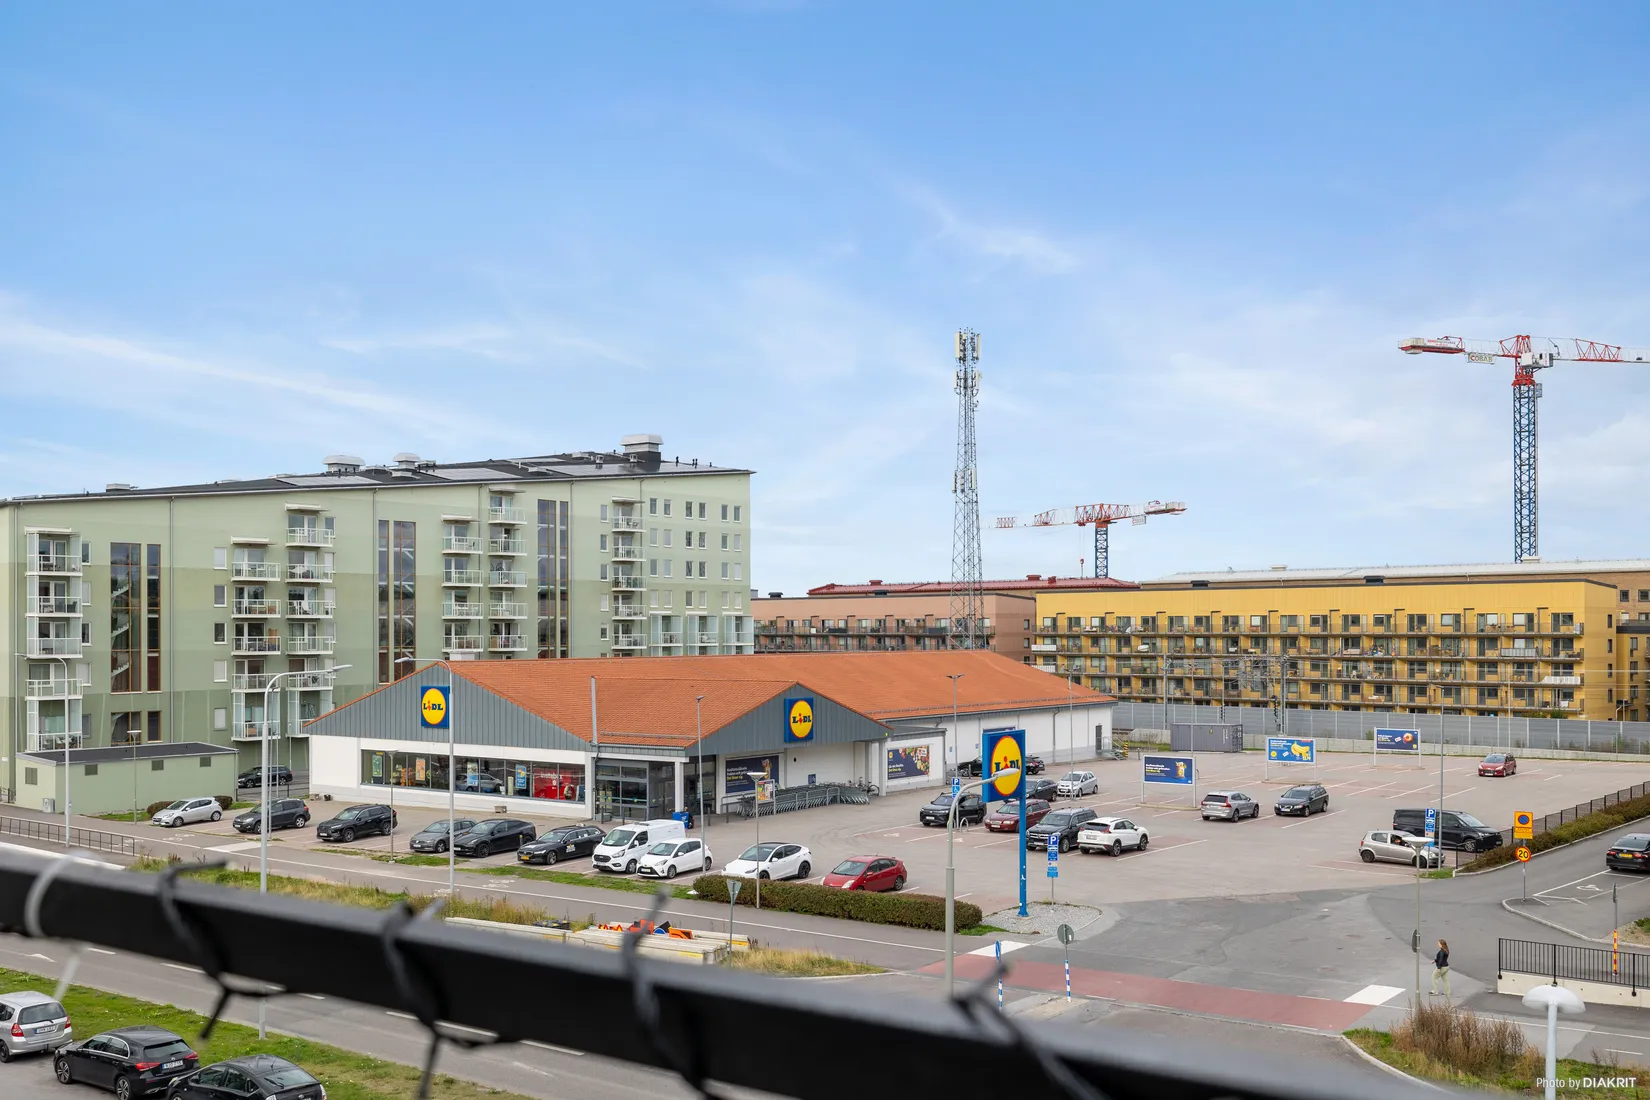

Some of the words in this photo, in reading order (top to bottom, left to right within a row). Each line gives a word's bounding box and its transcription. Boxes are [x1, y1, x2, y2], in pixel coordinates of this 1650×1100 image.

[1428, 809, 1434, 817] P
[1050, 836, 1057, 844] P
[1518, 850, 1528, 858] 20
